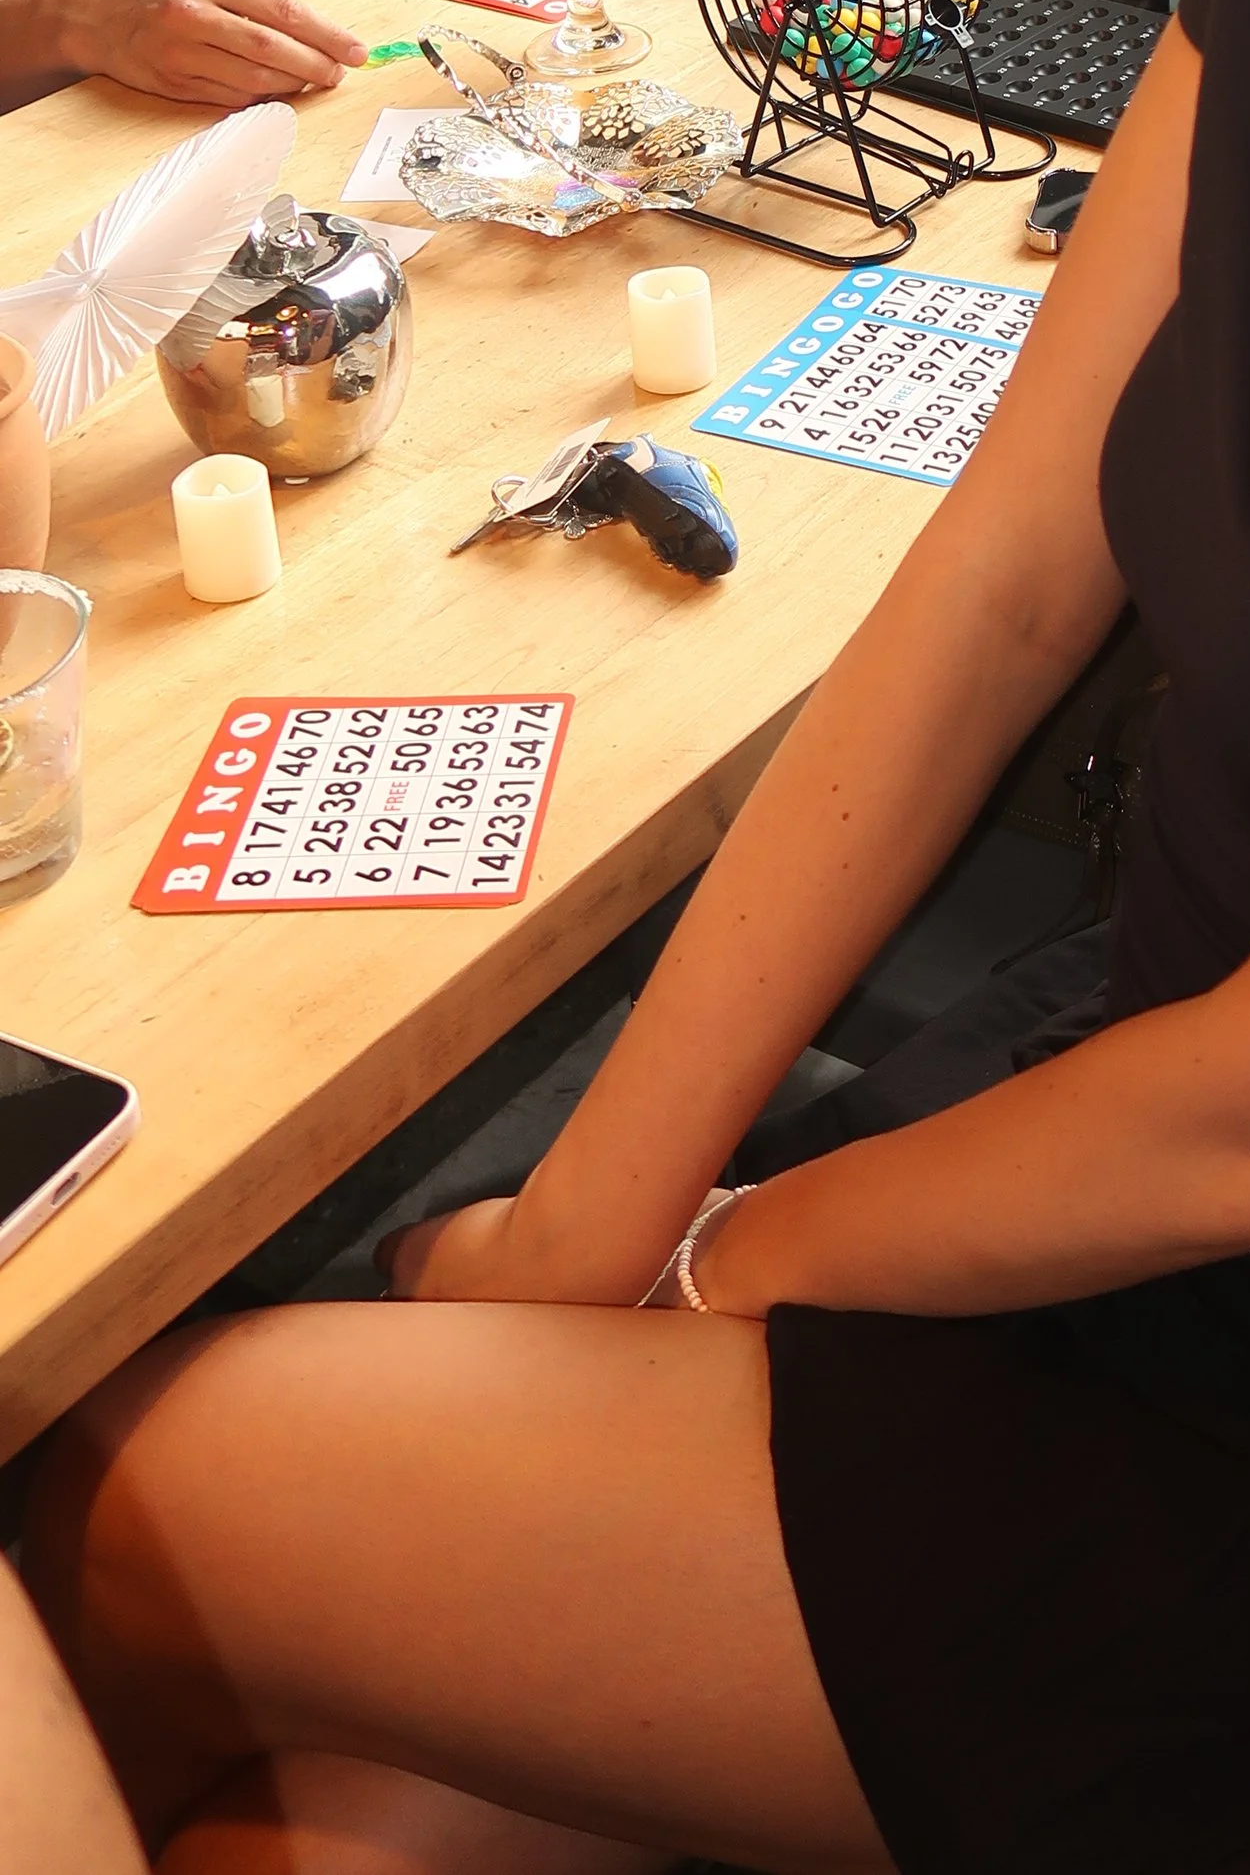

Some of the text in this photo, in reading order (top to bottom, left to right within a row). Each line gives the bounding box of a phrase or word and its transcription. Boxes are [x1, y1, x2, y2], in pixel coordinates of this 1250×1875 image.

[872, 278, 927, 320] 51 70
[912, 284, 967, 326] 52 73
[952, 291, 1006, 334] 59 63
[995, 320, 1029, 340] 46
[711, 314, 845, 426] BINGO
[760, 322, 886, 431] 9 21 44 60 64
[803, 330, 927, 442] 4 16 32 53 66
[838, 338, 968, 453] 15 26 FREE 59 72
[880, 346, 1008, 463] 11 20 31 50 75
[923, 451, 963, 473] 13
[945, 424, 984, 451] 25
[163, 711, 272, 894] BINGO
[231, 710, 331, 888] 8 17 41 46 70
[294, 709, 388, 884] 5 25 38 52 62
[355, 707, 443, 883] 6 22 FREE 50 65
[413, 705, 499, 882] 7 19 36 53 63
[473, 704, 553, 888] 14 23 31 54 74
